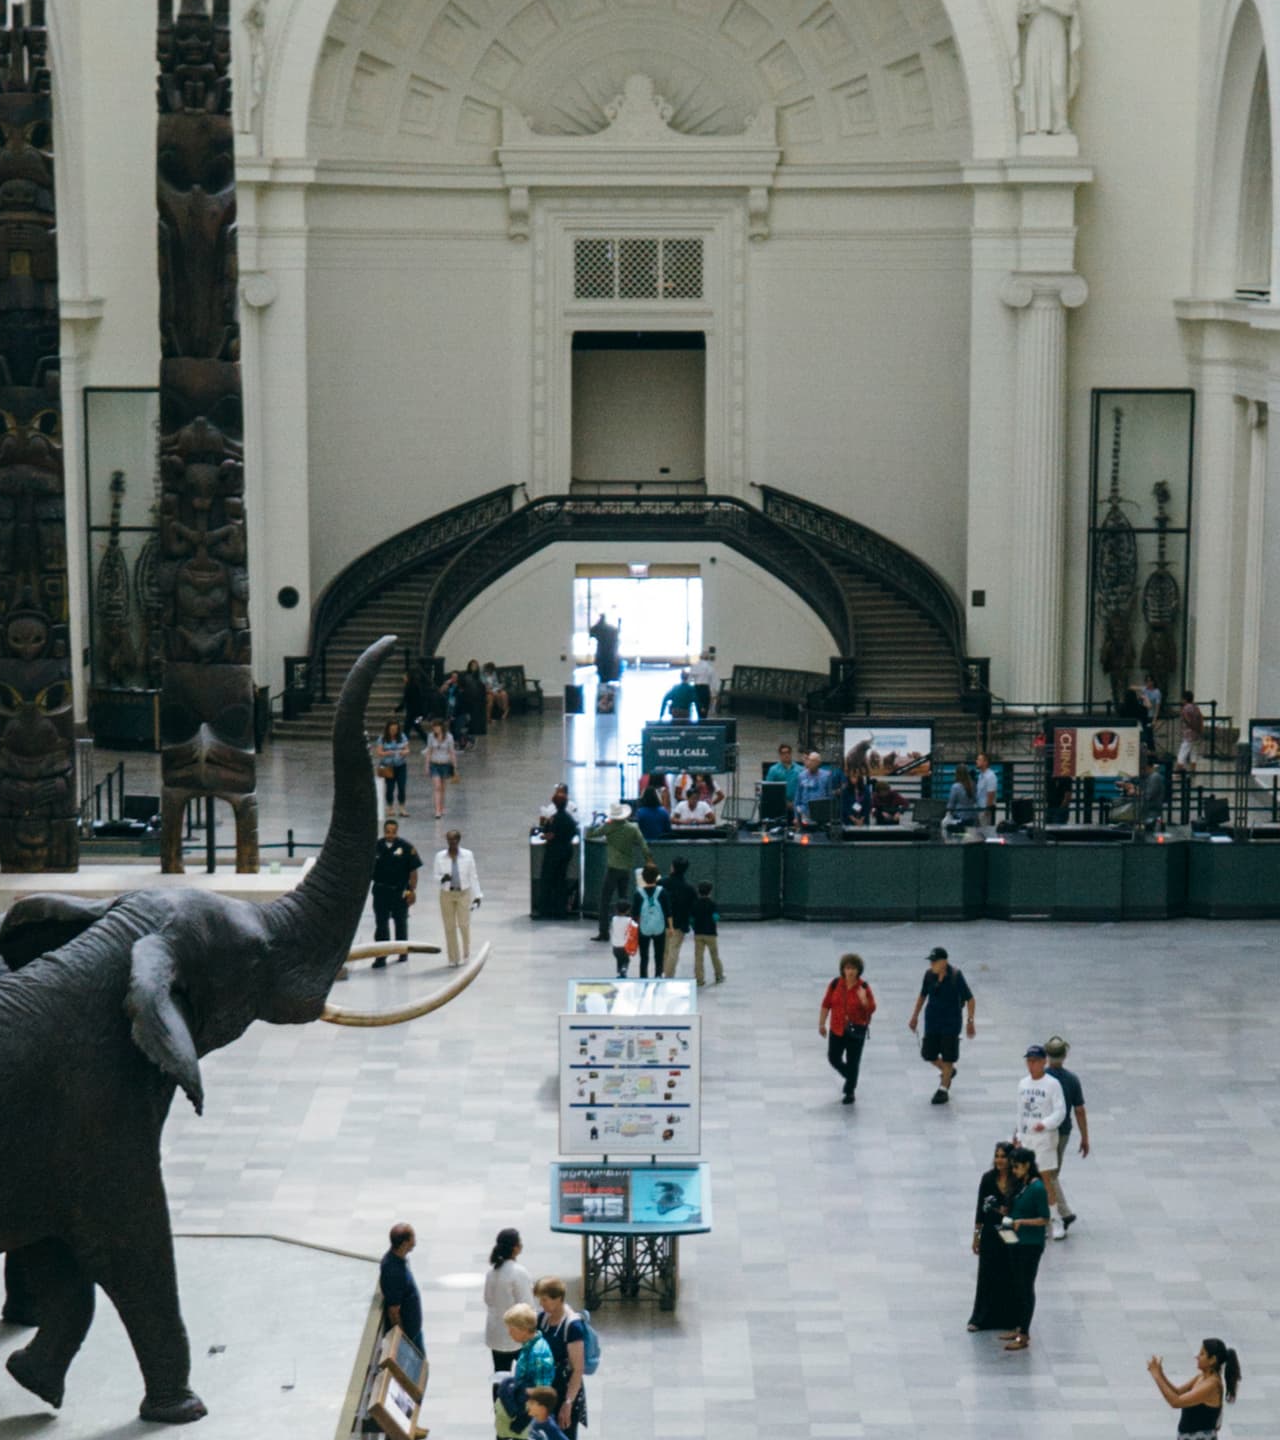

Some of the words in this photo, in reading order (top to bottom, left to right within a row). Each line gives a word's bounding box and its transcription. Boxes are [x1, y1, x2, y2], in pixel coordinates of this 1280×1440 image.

[657, 748, 681, 757] WILL
[683, 748, 708, 757] CALL
[1060, 733, 1072, 775] CHINA
